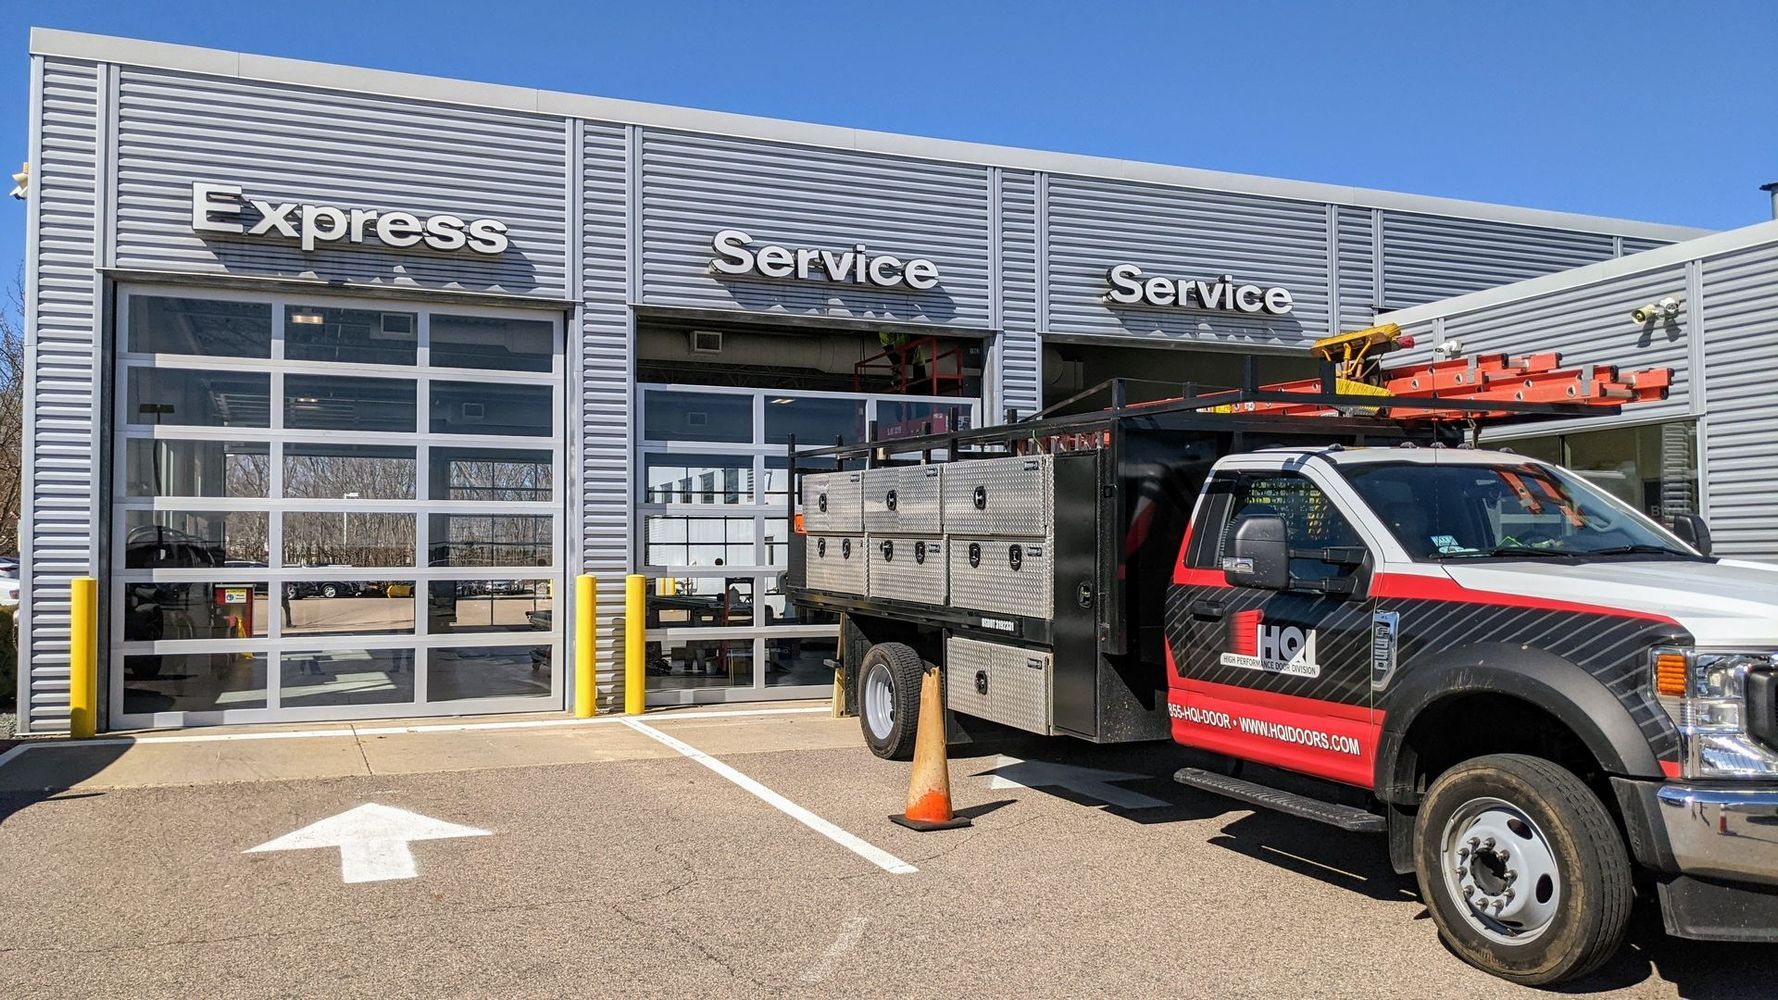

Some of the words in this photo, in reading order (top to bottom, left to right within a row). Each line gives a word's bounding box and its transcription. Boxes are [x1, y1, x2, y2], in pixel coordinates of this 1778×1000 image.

[191, 181, 509, 254] Express
[709, 229, 940, 290] Service
[1104, 264, 1294, 315] Service
[1223, 655, 1236, 664] HIGH
[1237, 657, 1275, 670] PERFORMANCE
[1275, 661, 1291, 671] DOOR
[1291, 664, 1316, 676] DIVISION
[1258, 624, 1316, 665] HQI
[1239, 716, 1360, 756] WWW.HQIDOORS.COM
